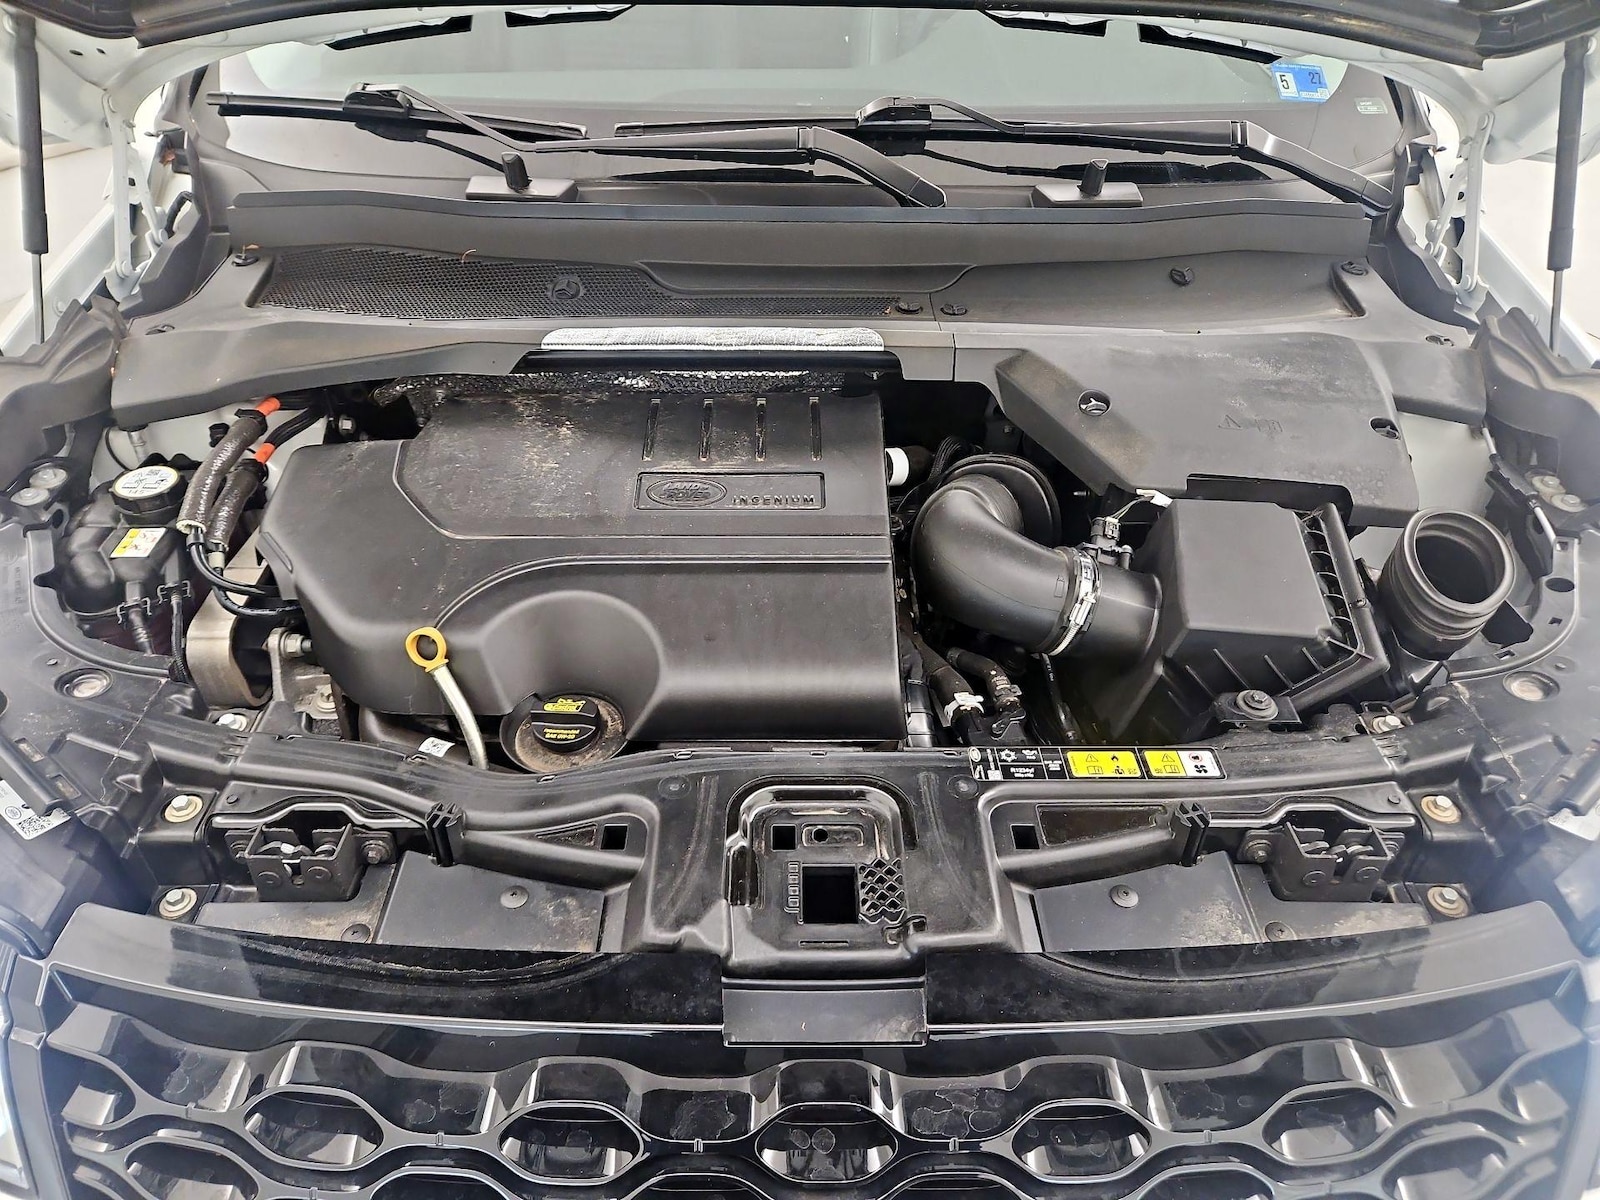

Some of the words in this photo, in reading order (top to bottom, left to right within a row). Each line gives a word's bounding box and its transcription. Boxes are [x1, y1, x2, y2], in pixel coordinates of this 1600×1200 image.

[1279, 74, 1290, 90] 5
[1308, 71, 1322, 85] 27
[732, 494, 815, 506] INGENIUM
